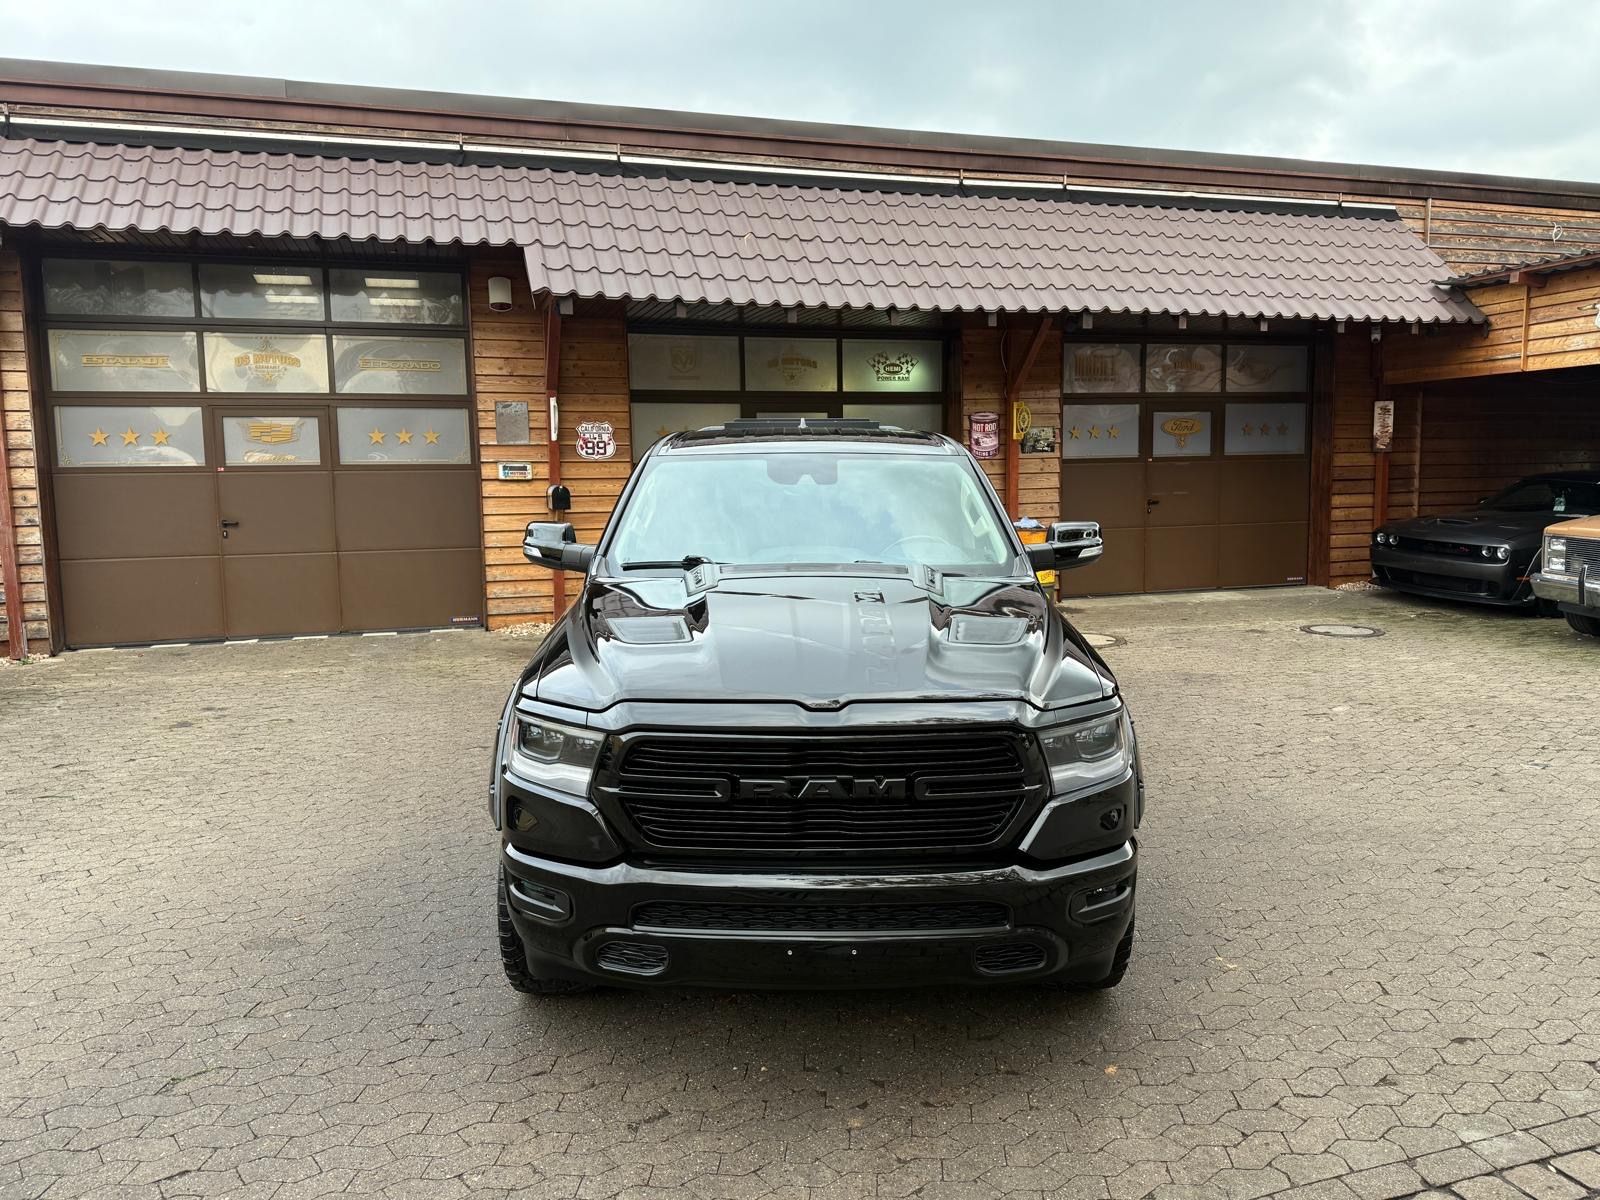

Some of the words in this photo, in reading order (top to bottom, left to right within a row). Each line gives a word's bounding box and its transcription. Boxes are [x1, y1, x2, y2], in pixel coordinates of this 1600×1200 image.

[234, 353, 250, 368] US
[253, 352, 301, 368] MOTORS
[359, 359, 441, 372] ELDORADO
[884, 365, 902, 373] HEMI
[972, 422, 985, 433] HOT
[985, 422, 998, 433] ROD
[1170, 419, 1196, 432] Ford
[585, 440, 607, 456] 99
[739, 776, 907, 800] RAM
